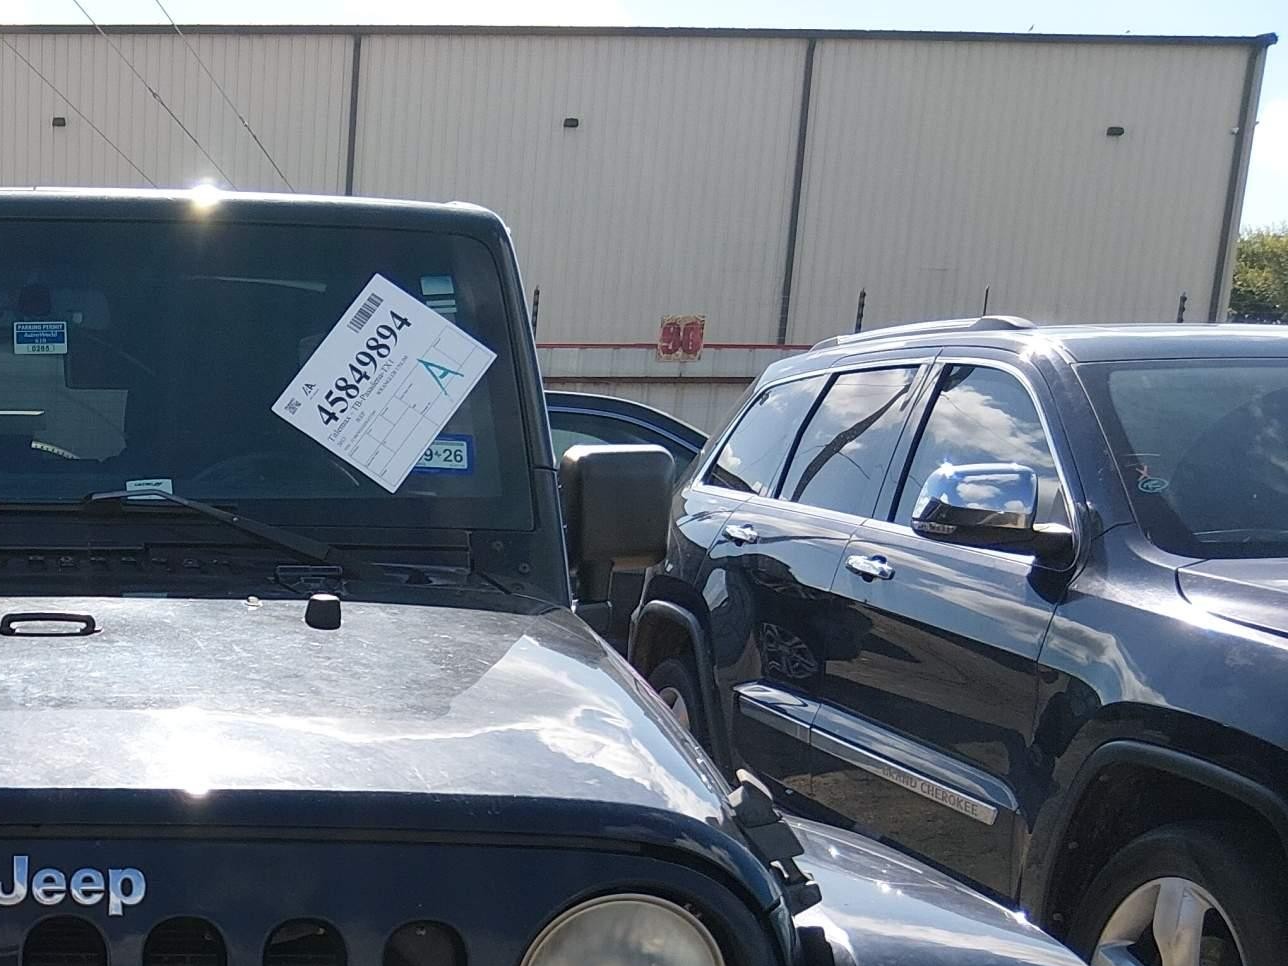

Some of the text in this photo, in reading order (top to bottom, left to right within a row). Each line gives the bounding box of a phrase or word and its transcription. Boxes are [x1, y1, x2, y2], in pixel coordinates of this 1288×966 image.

[316, 309, 413, 428] 45849894
[417, 357, 464, 397] A
[442, 448, 464, 463] 26
[920, 782, 978, 817] CHEROKEE
